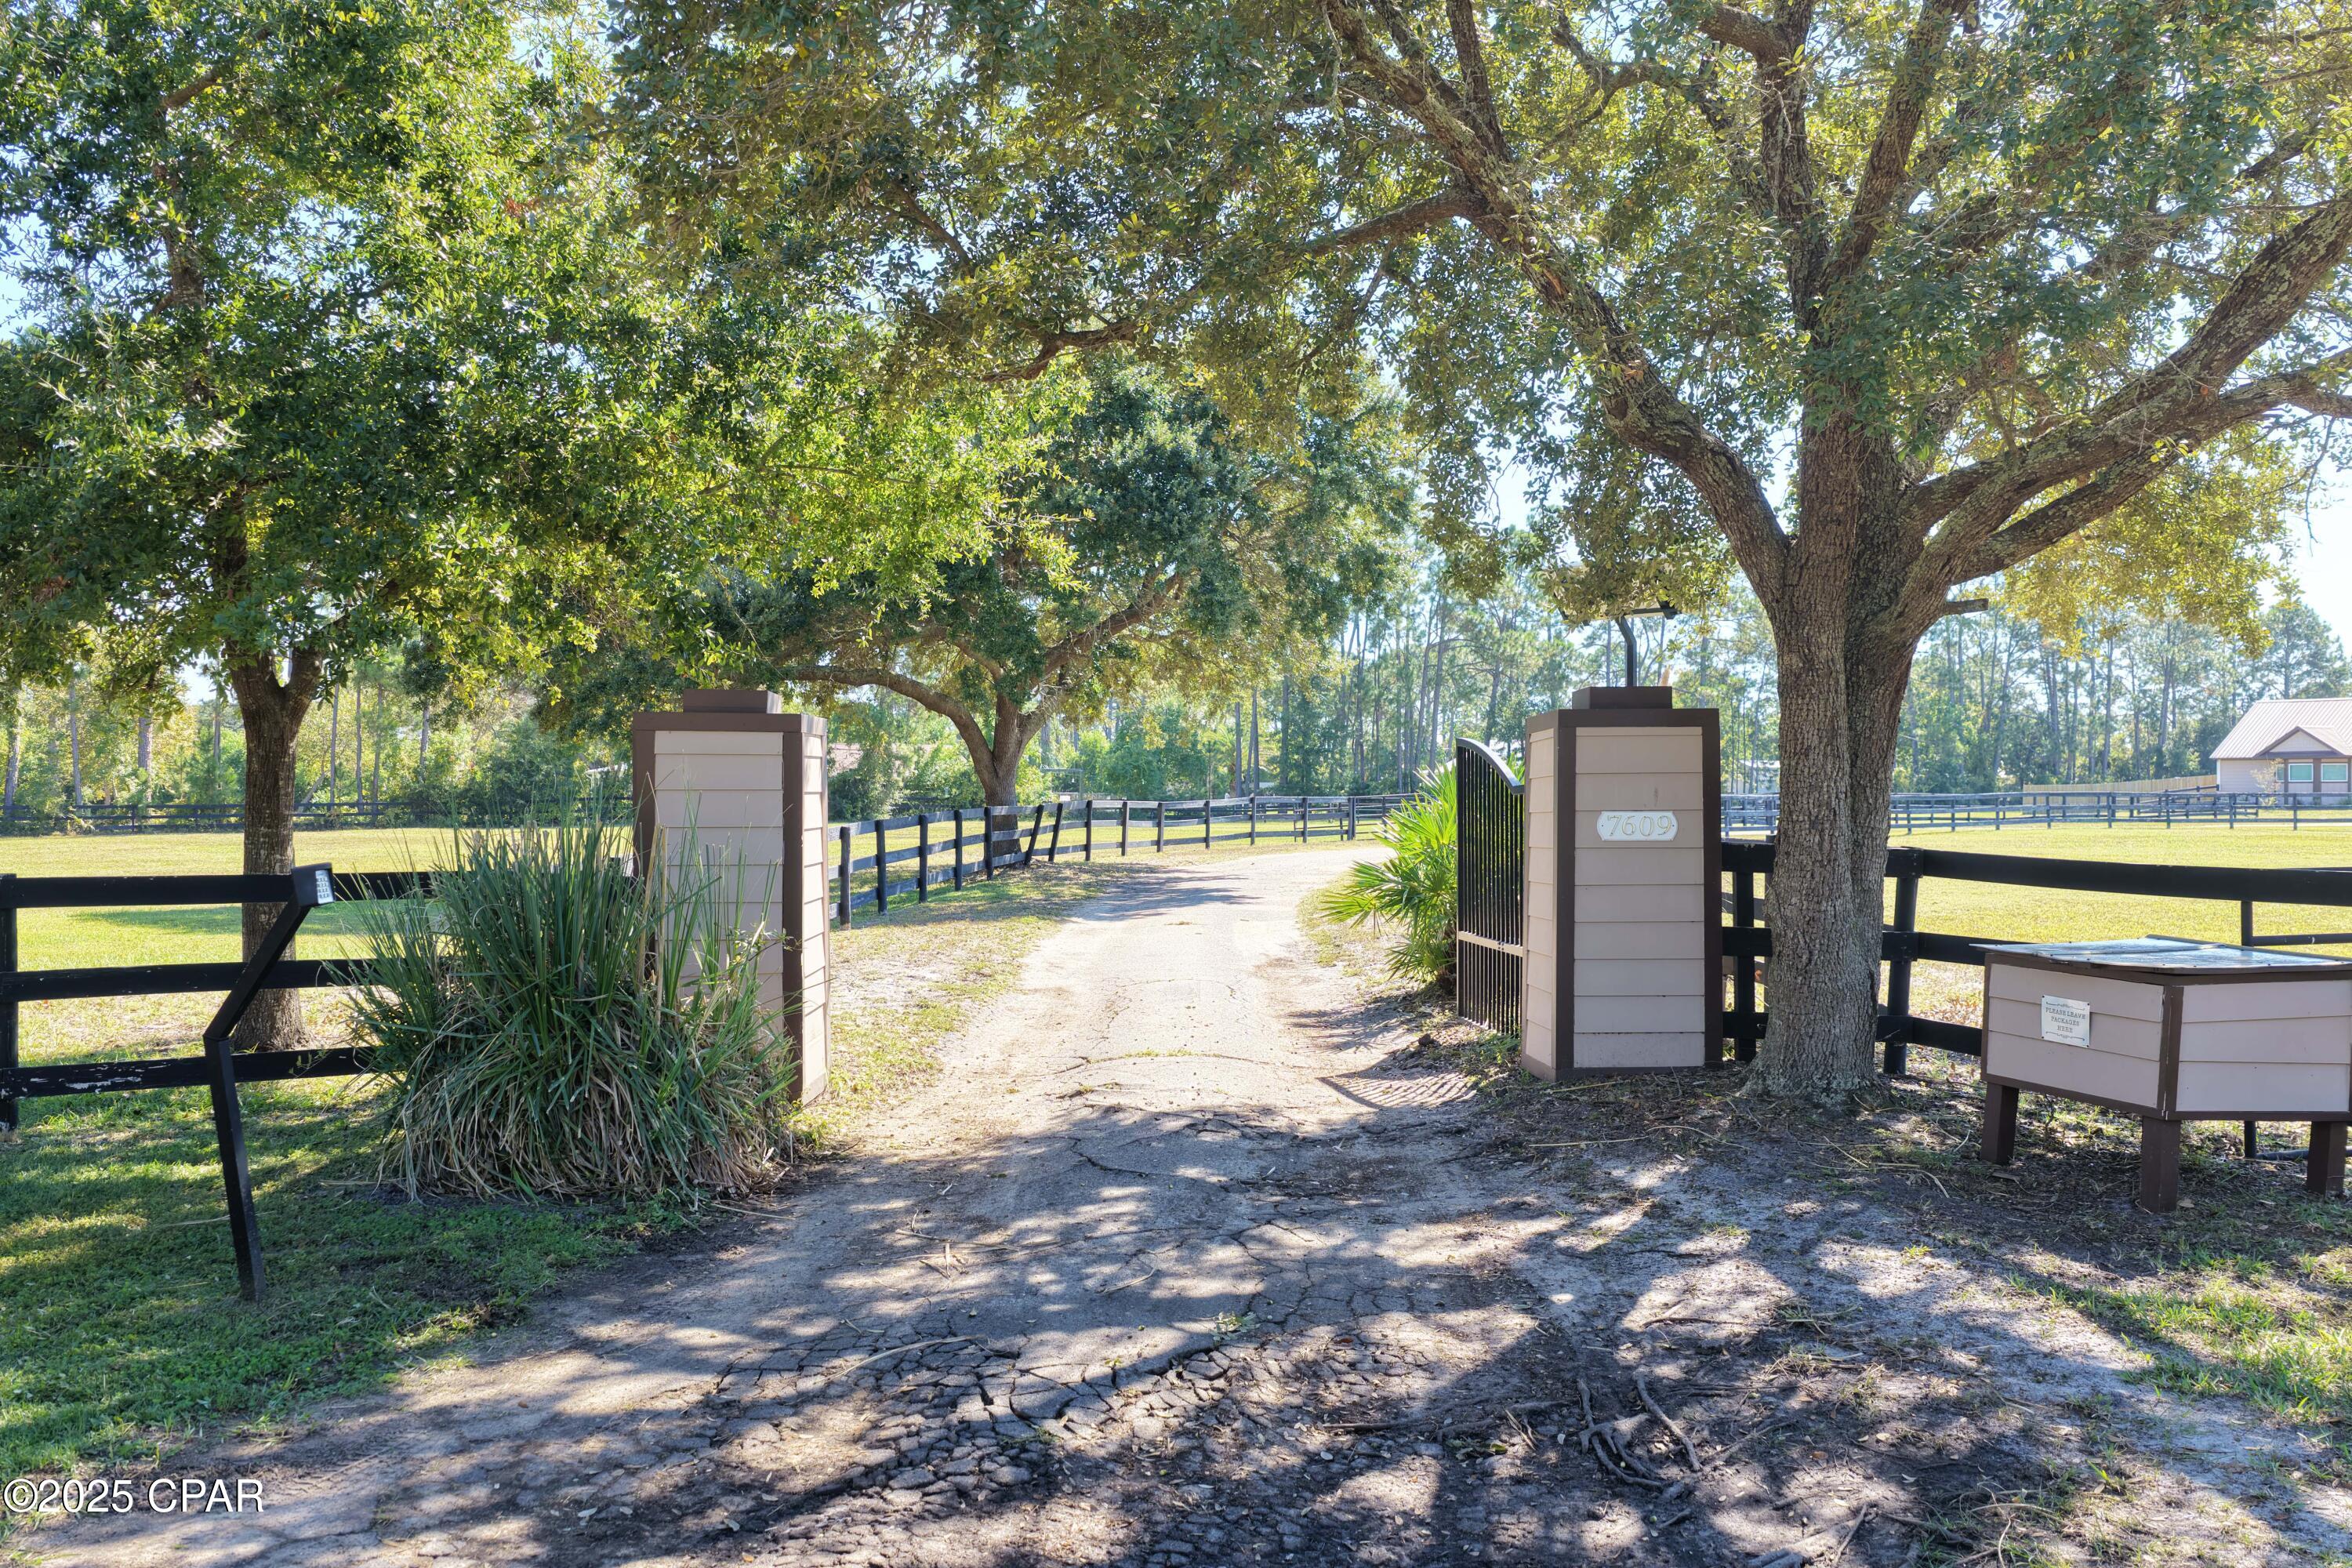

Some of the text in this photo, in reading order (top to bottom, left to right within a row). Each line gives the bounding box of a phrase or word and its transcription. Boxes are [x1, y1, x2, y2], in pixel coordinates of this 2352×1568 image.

[1607, 815, 1672, 837] 7609
[2045, 1007, 2066, 1016] PLEASE
[2051, 1016, 2080, 1026] PACKAGES
[2057, 1025, 2074, 1033] HERE
